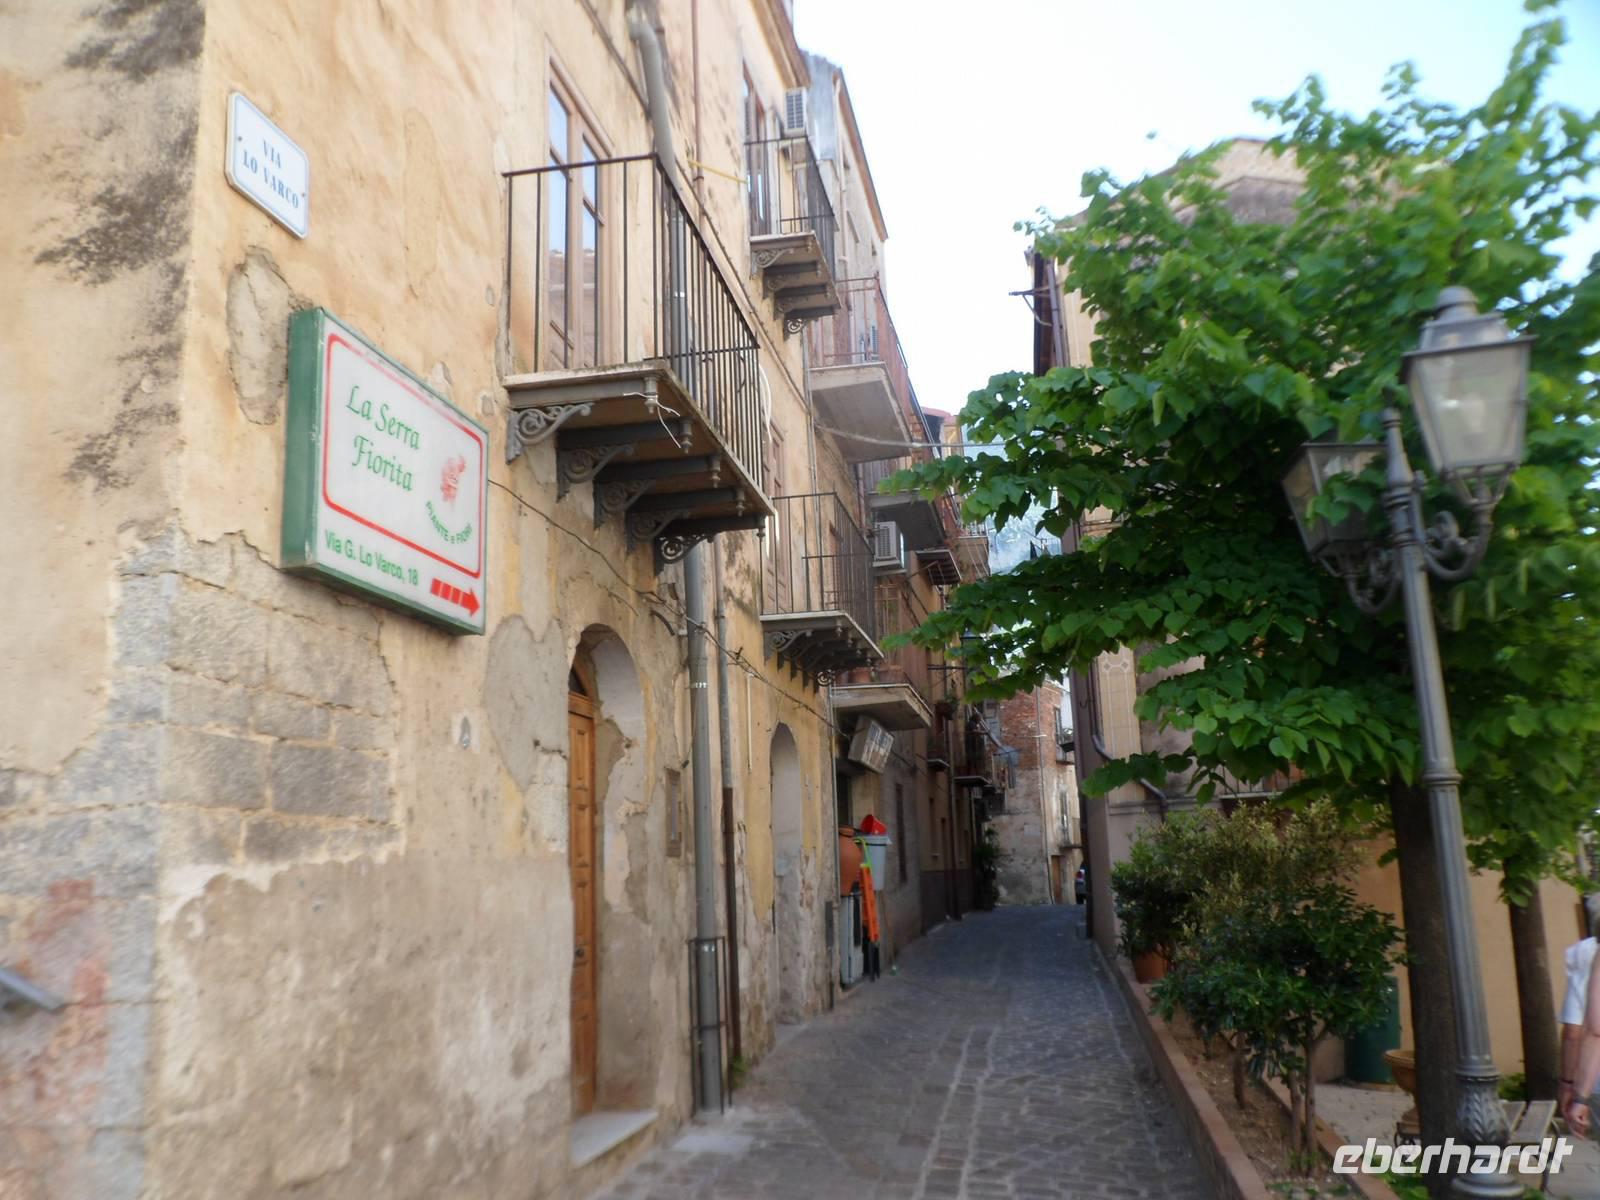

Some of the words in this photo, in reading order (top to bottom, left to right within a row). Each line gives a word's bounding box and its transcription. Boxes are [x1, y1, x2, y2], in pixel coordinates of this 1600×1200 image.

[243, 150, 259, 174] LO
[264, 167, 299, 209] VARCO
[263, 138, 282, 168] VIA
[345, 385, 372, 420] La
[374, 403, 420, 450] Serra
[351, 435, 413, 492] Fiorita
[325, 528, 342, 554] Via
[345, 539, 356, 560] G.
[360, 545, 372, 567] Lo
[374, 551, 405, 584] Varco,
[408, 567, 419, 586] 18
